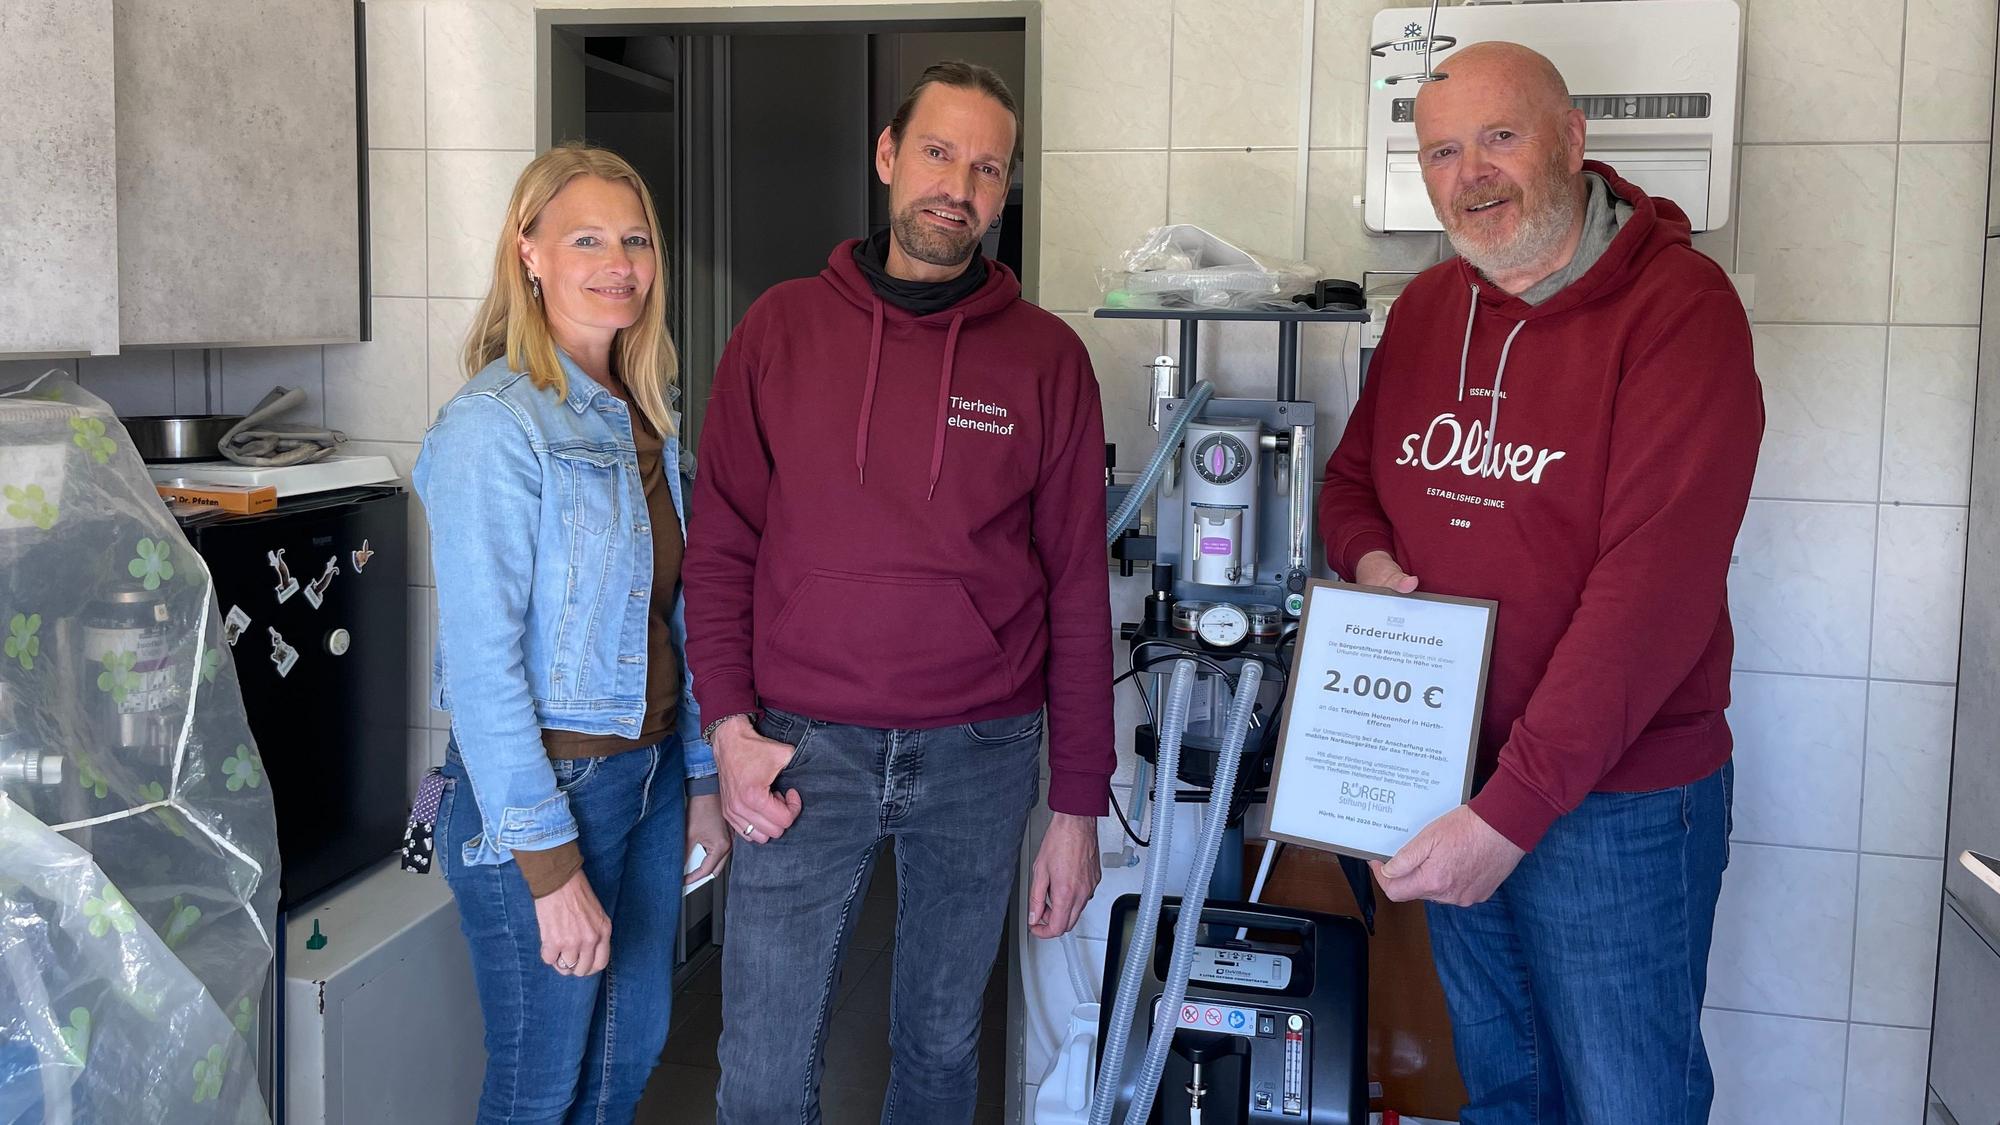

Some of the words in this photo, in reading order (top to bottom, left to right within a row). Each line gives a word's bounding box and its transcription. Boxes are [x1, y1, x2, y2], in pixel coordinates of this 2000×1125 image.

[1470, 388, 1507, 399] ESSENTAL
[950, 396, 1007, 418] Tierheim
[948, 414, 1015, 435] elenenhof
[179, 496, 190, 504] Dr.
[1427, 487, 1482, 505] ESTABLISHED
[1483, 498, 1505, 509] SINCE
[1450, 518, 1471, 529] 1969
[1345, 624, 1444, 647] Förderurkunde
[1339, 642, 1382, 655] Bürgerstiftung
[1383, 648, 1401, 657] Hürth
[1373, 653, 1405, 665] Förderung
[1323, 669, 1412, 704] 2.000
[1422, 686, 1444, 709] €
[1328, 704, 1339, 713] das
[1341, 707, 1370, 718] Tierheim
[1371, 712, 1411, 725] Helenenhof
[1421, 720, 1444, 730] Hürth-
[1366, 719, 1392, 729] Efferen
[1330, 736, 1377, 750] Narkosegerätes
[1379, 744, 1389, 752] für
[1385, 739, 1424, 752] Anschaffung
[1340, 781, 1396, 805] BÜRGER
[1338, 795, 1367, 811] Stiftung
[1372, 802, 1393, 814] Hürth
[1345, 814, 1356, 823] Mai
